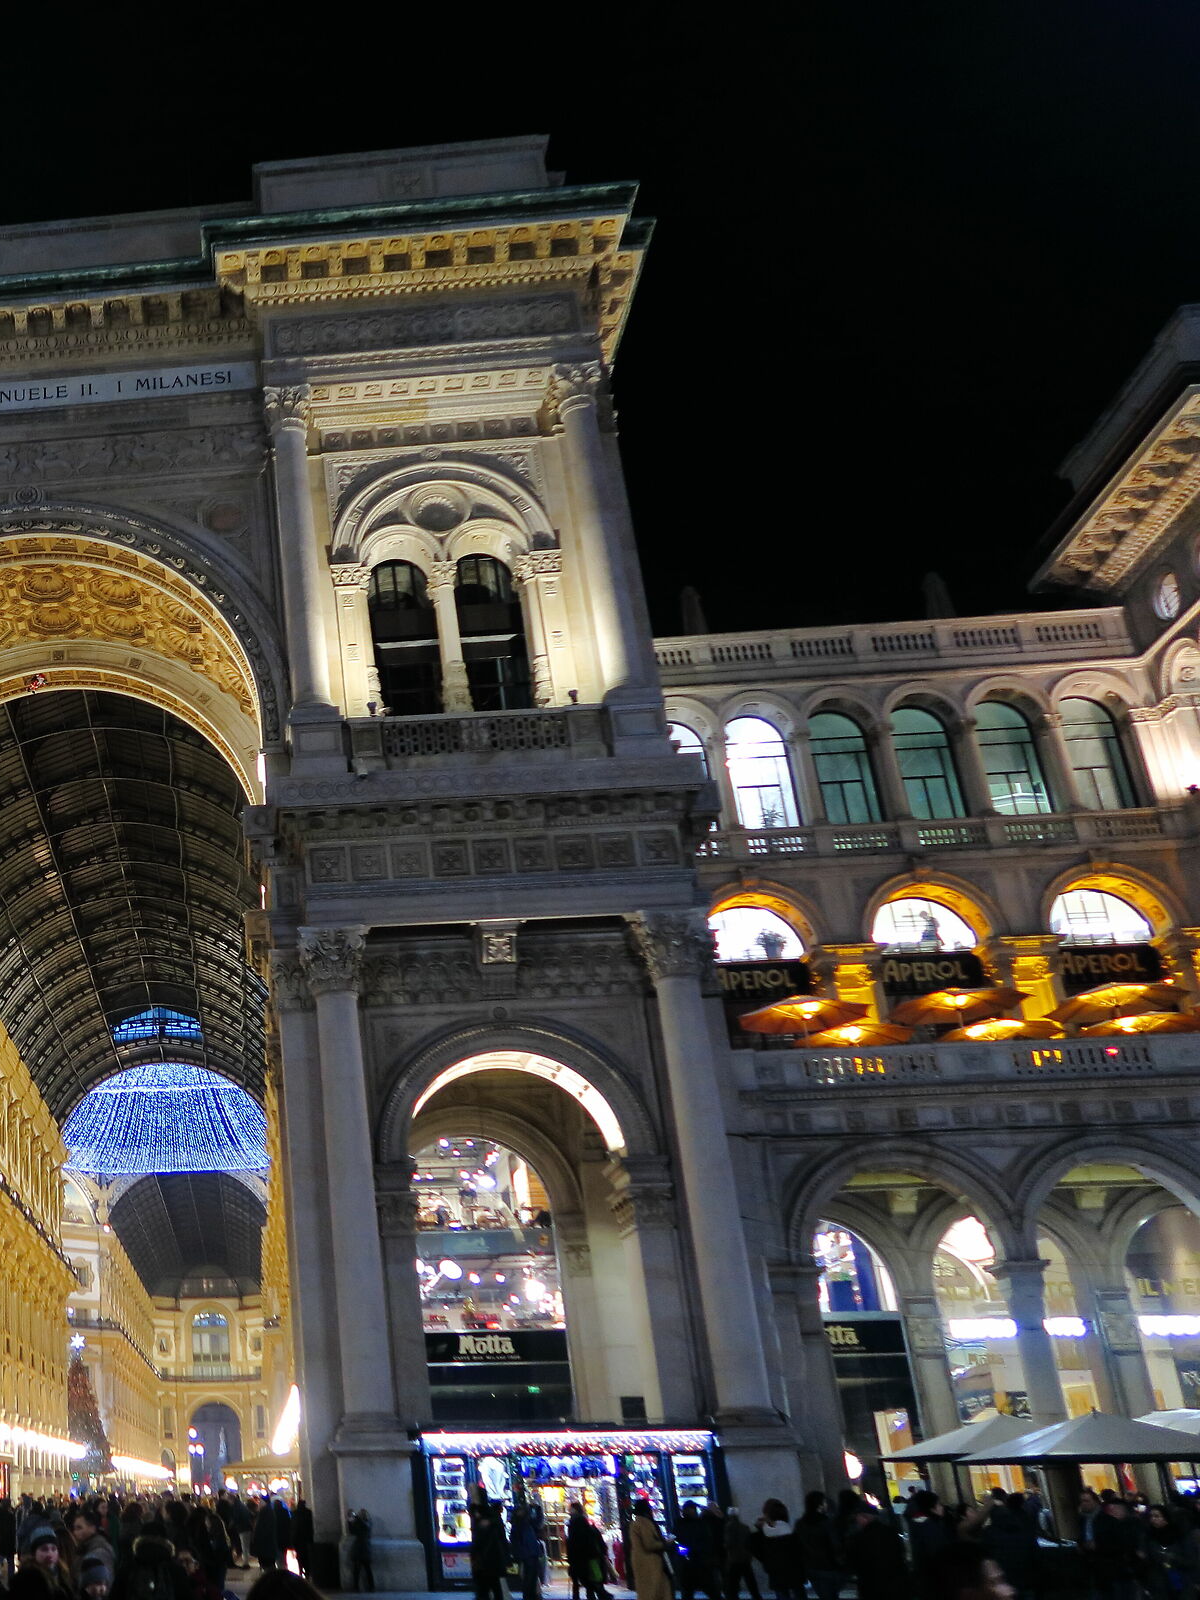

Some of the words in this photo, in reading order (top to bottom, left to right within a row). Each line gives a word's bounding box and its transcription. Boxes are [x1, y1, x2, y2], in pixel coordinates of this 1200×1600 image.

[81, 383, 99, 397] II.
[117, 380, 122, 393] I
[135, 370, 232, 391] MILANESI
[883, 959, 968, 982] APEROL
[1060, 952, 1148, 975] APEROL
[717, 968, 797, 990] APEROL
[458, 1334, 516, 1355] Motta
